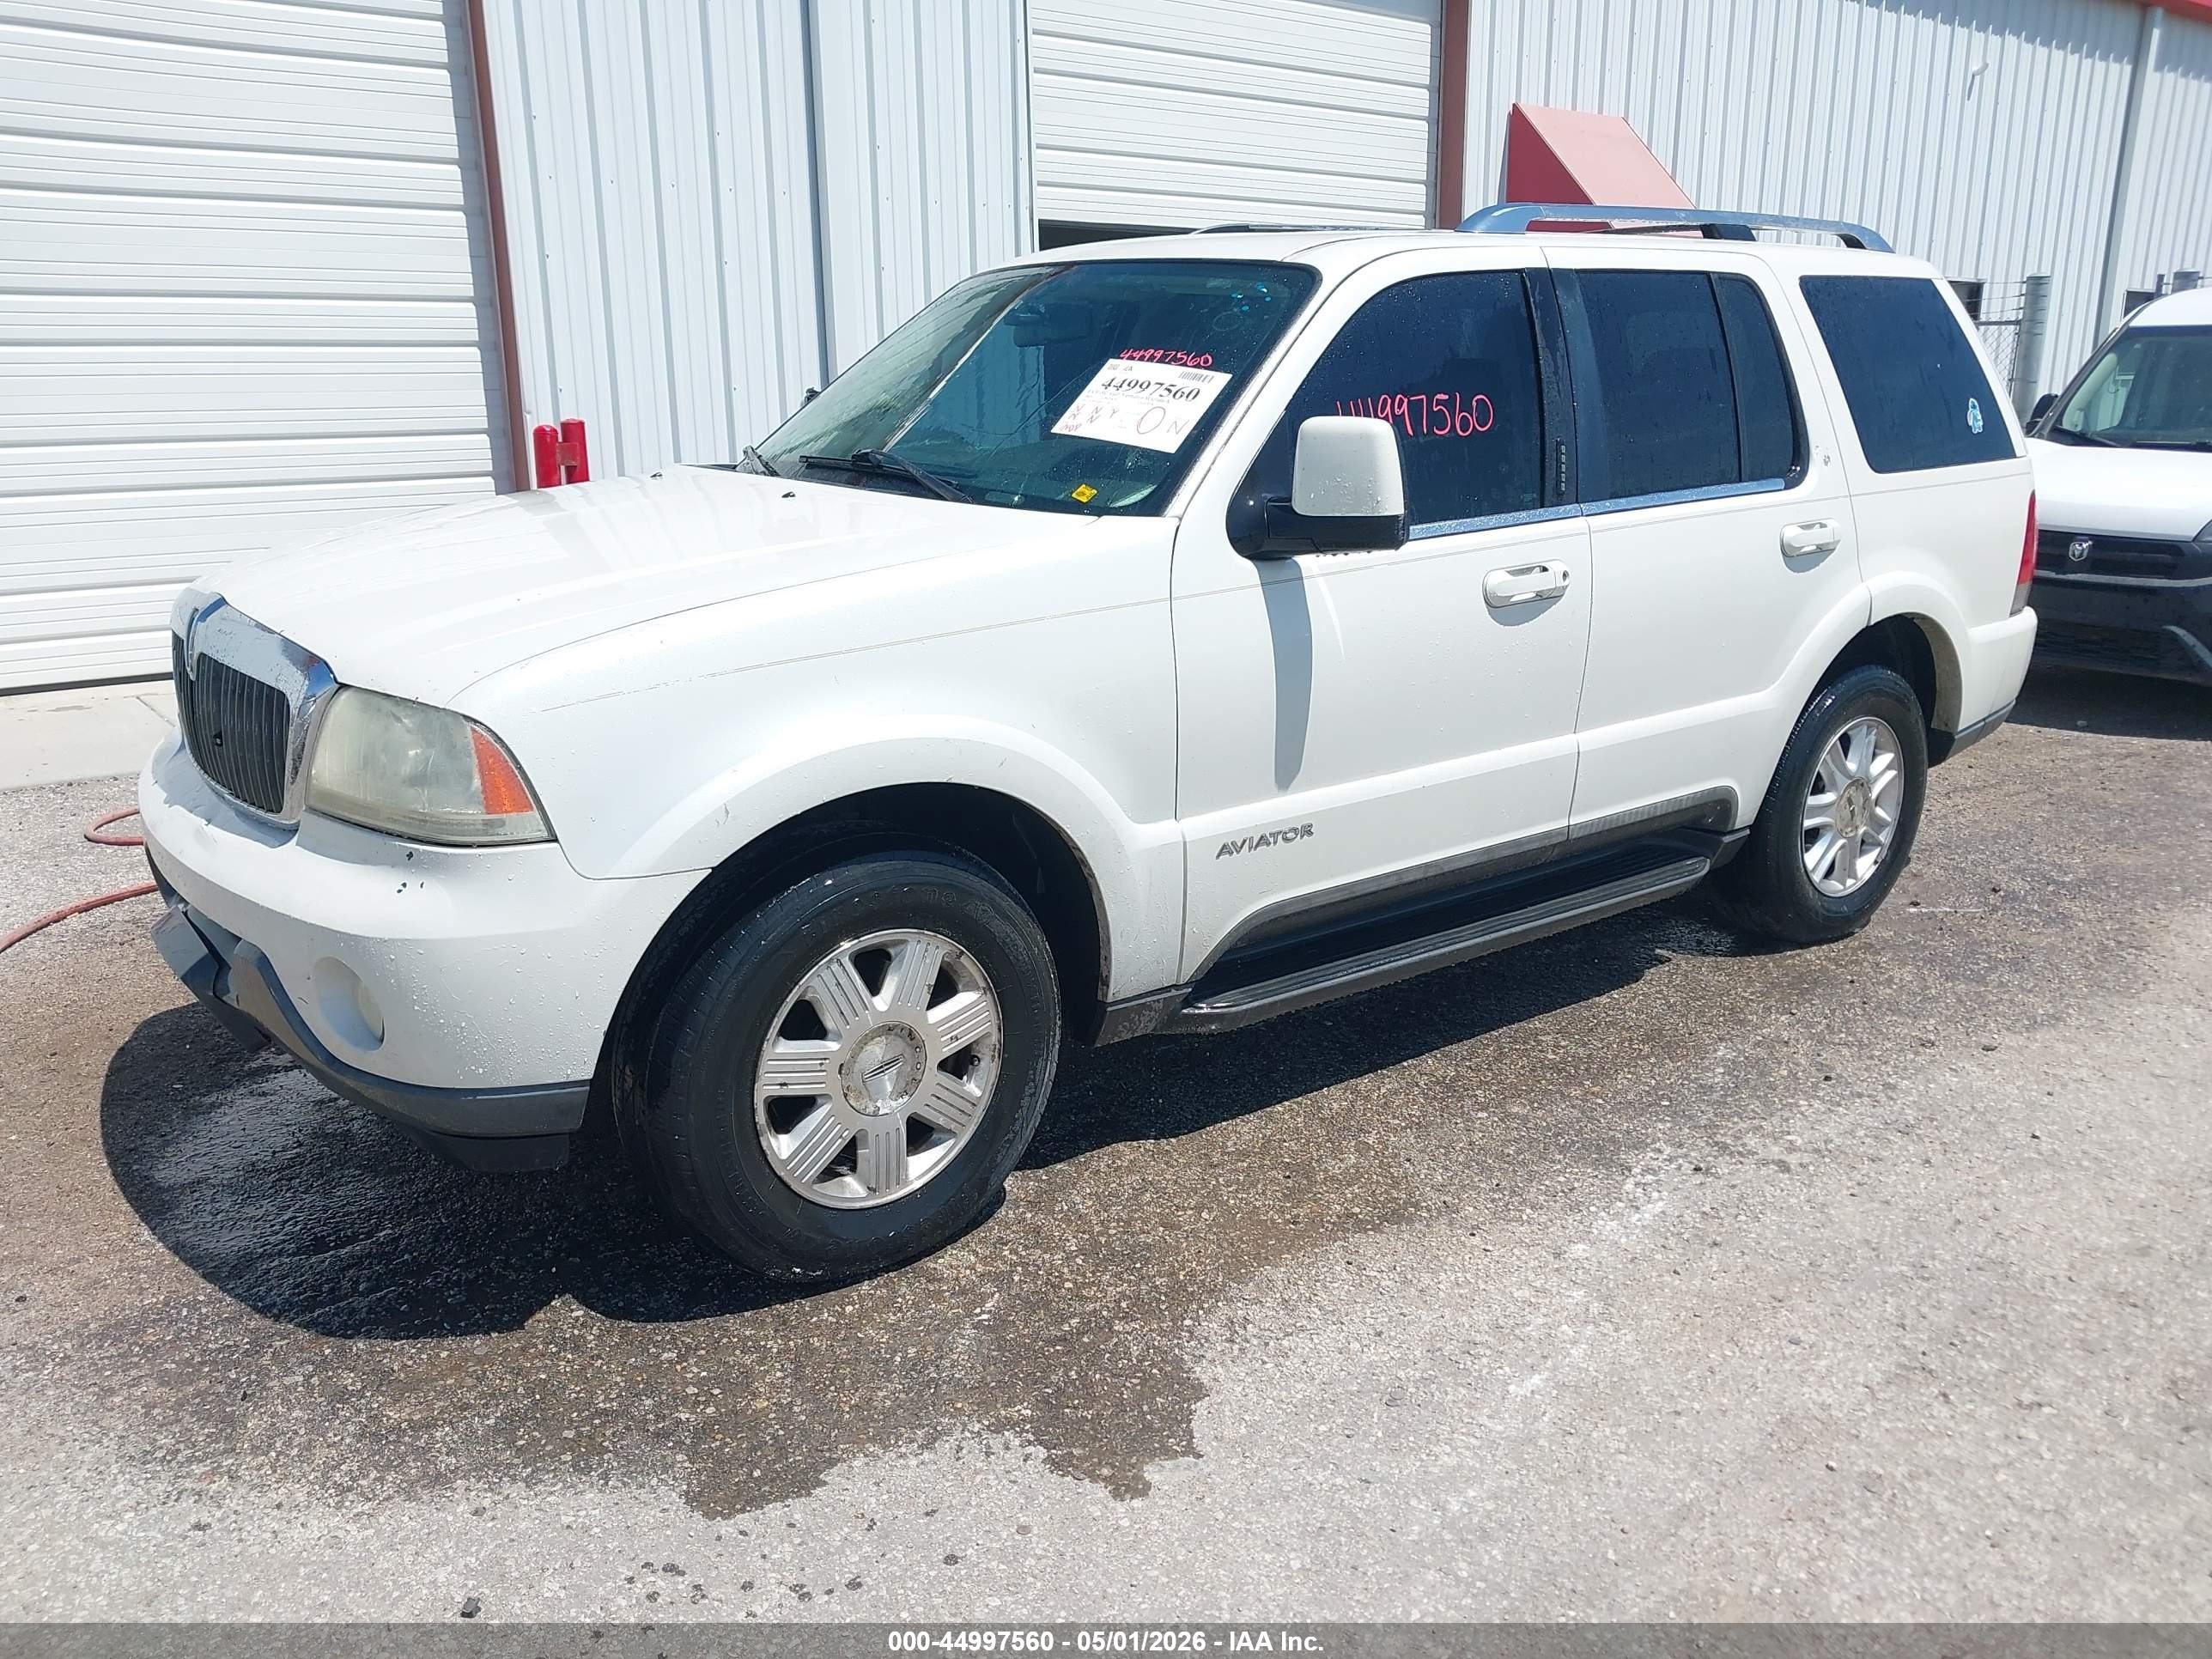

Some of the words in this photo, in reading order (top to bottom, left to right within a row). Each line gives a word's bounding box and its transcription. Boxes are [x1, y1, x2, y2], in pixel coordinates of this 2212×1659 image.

[1120, 349, 1213, 367] 44997560
[1101, 377, 1201, 403] 44997560
[1215, 823, 1314, 860] AVIATOR
